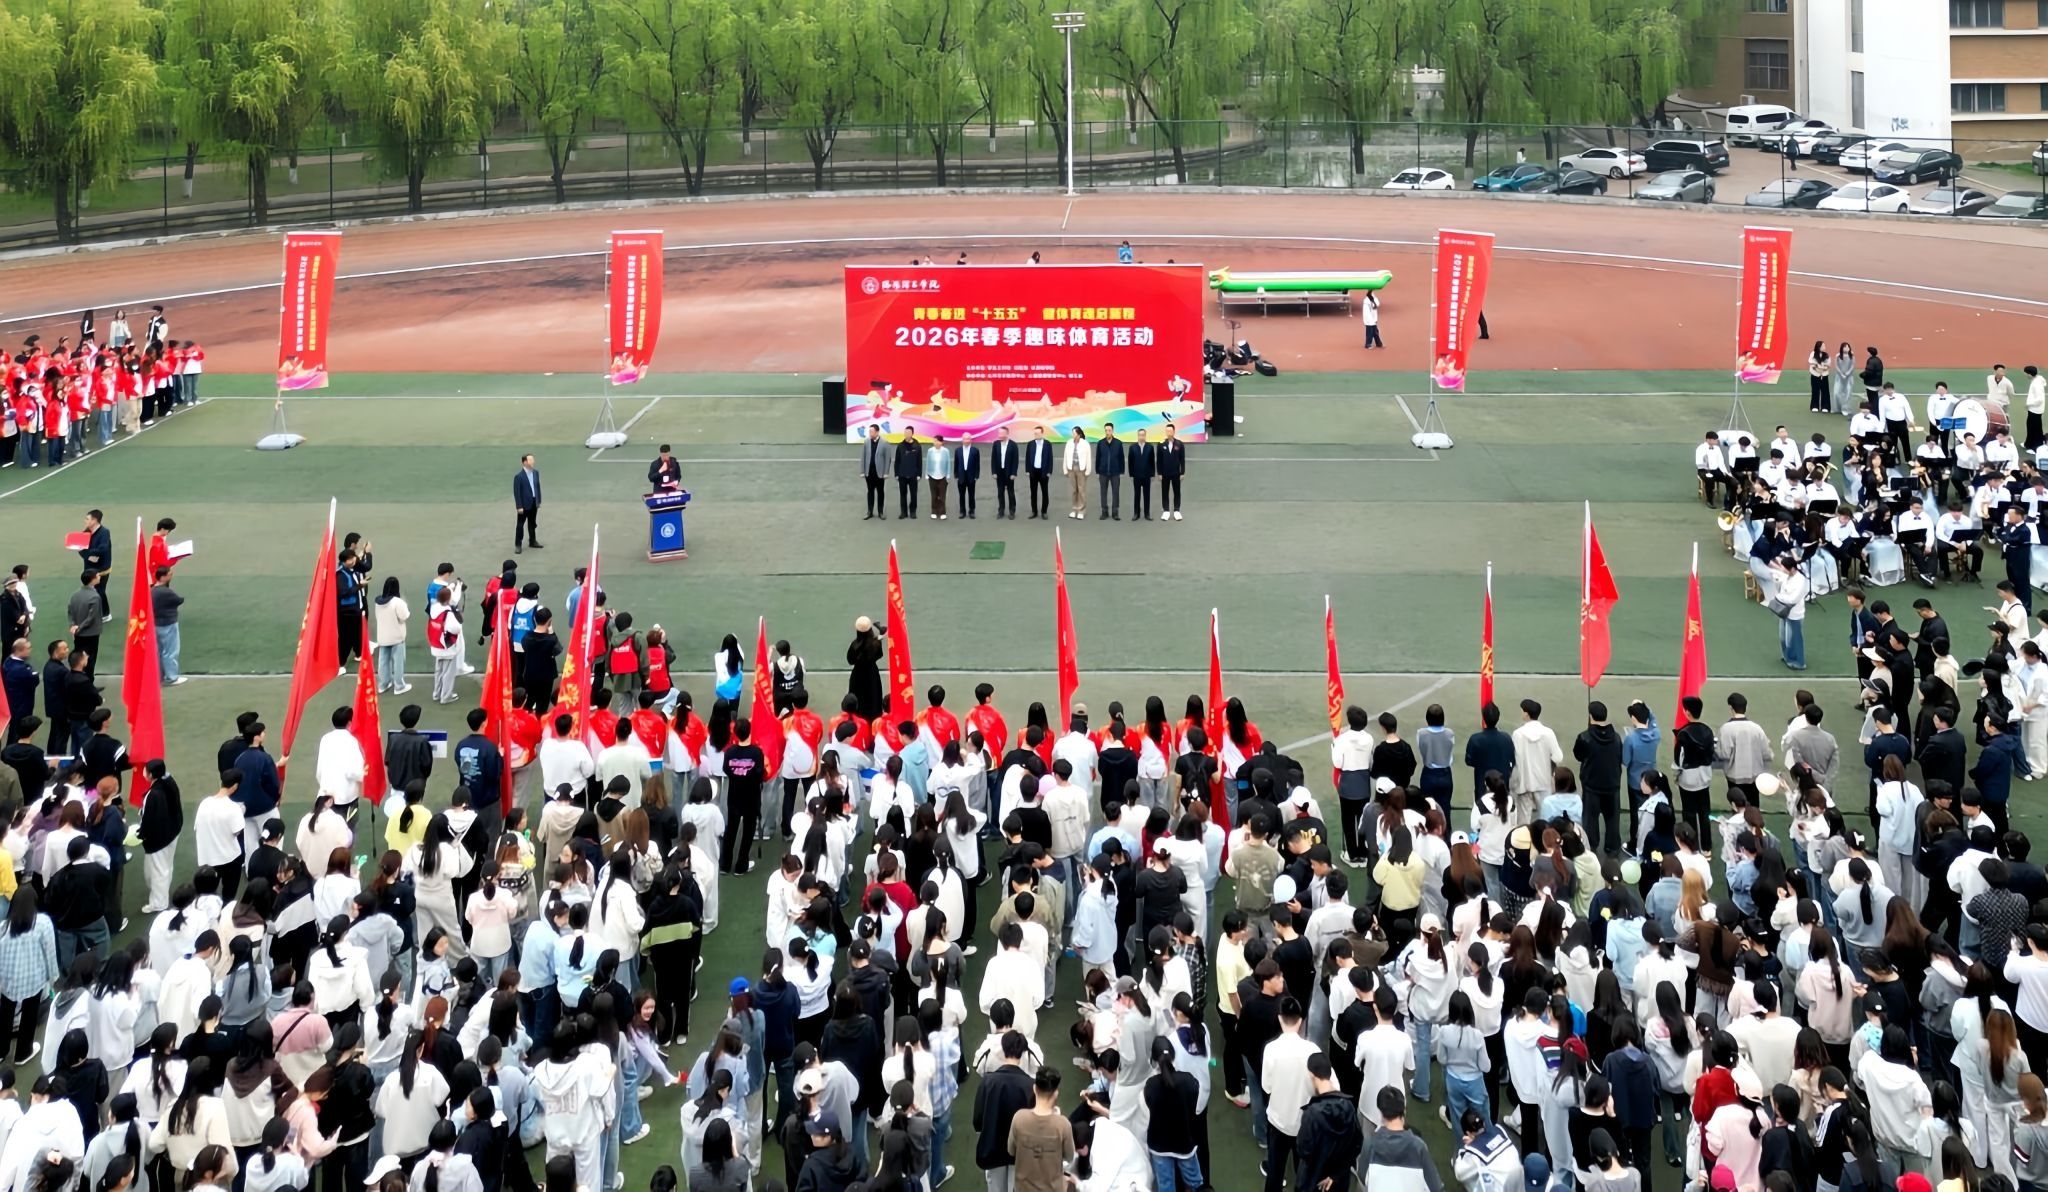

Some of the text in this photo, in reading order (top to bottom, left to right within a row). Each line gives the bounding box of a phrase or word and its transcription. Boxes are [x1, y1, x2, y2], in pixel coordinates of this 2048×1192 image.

[895, 326, 1154, 347] 2026年春季趣味体育活动
